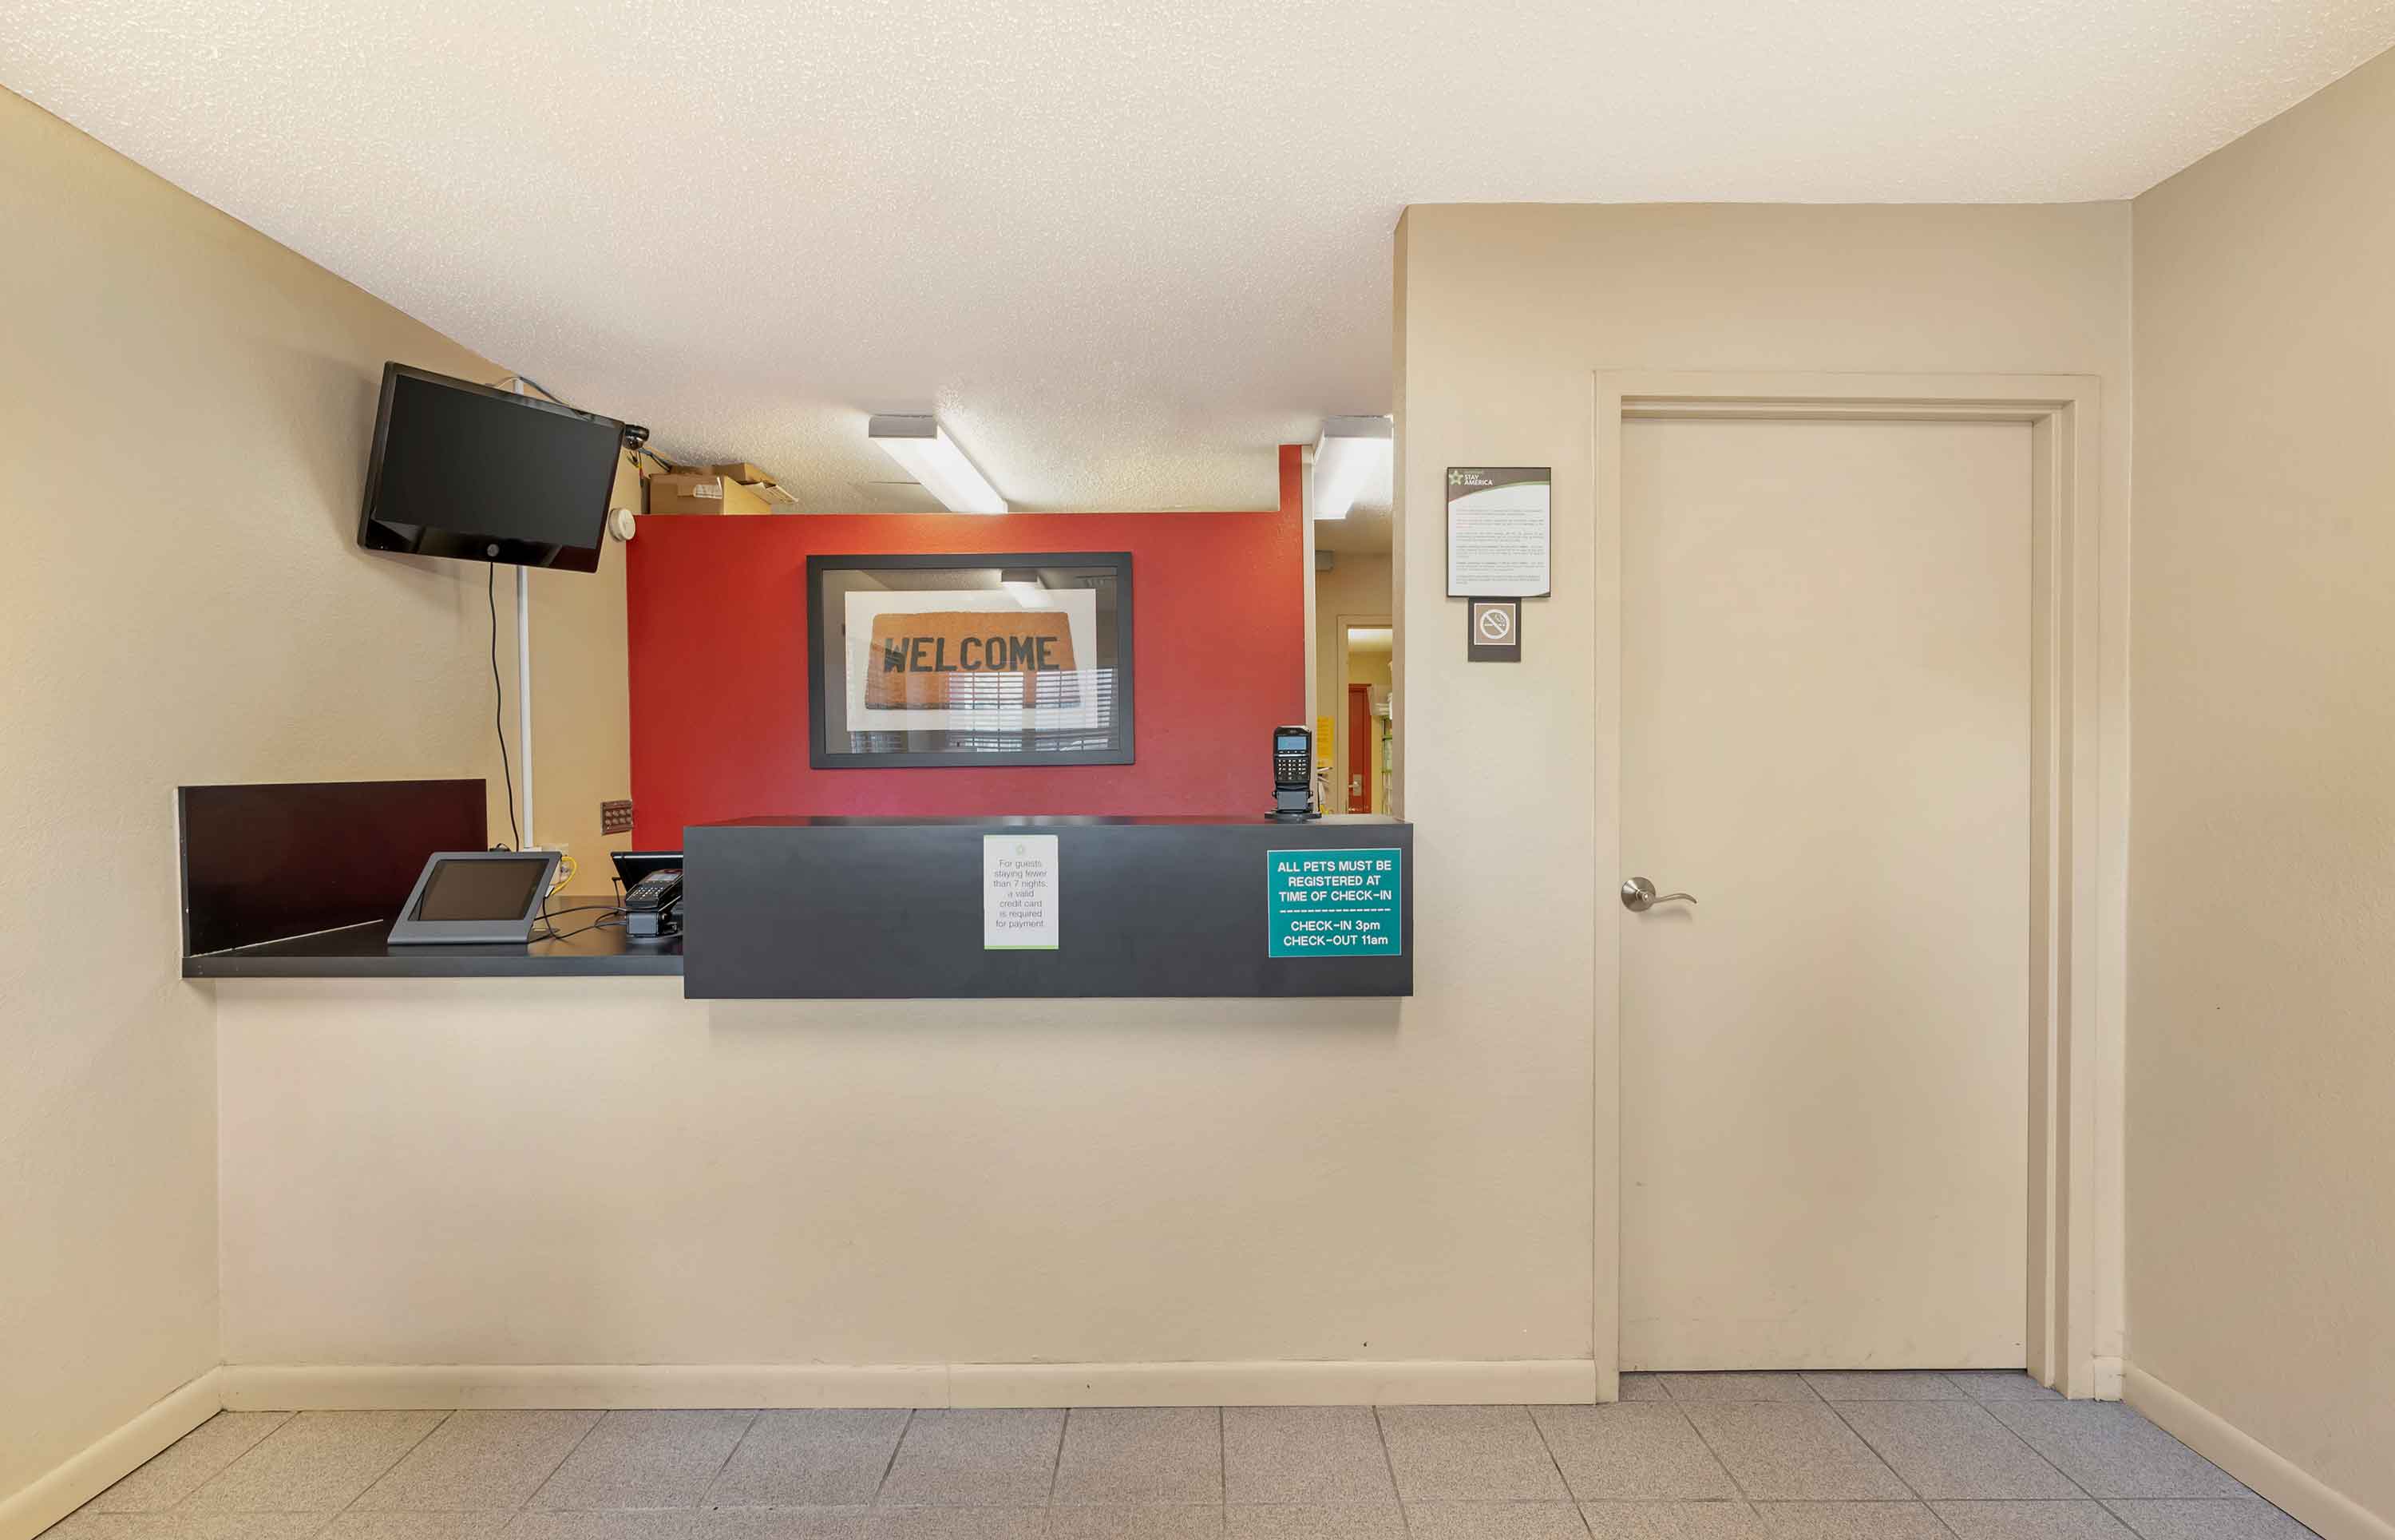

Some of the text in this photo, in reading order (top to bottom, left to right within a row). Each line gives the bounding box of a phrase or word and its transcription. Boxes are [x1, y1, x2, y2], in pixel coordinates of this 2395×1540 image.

[883, 635, 1060, 673] WELCOME
[1015, 860, 1042, 869] guests
[1277, 861, 1391, 873] ALL PETS MUST BE
[994, 869, 1023, 879] staying
[1288, 876, 1381, 887] REGISTERED AT
[1278, 890, 1392, 901] TIME OF CHECK-IN
[1008, 910, 1043, 919] required
[1291, 920, 1380, 932] CHECK-IN 3pm
[1283, 935, 1388, 946] CHECK-OUT 11am
